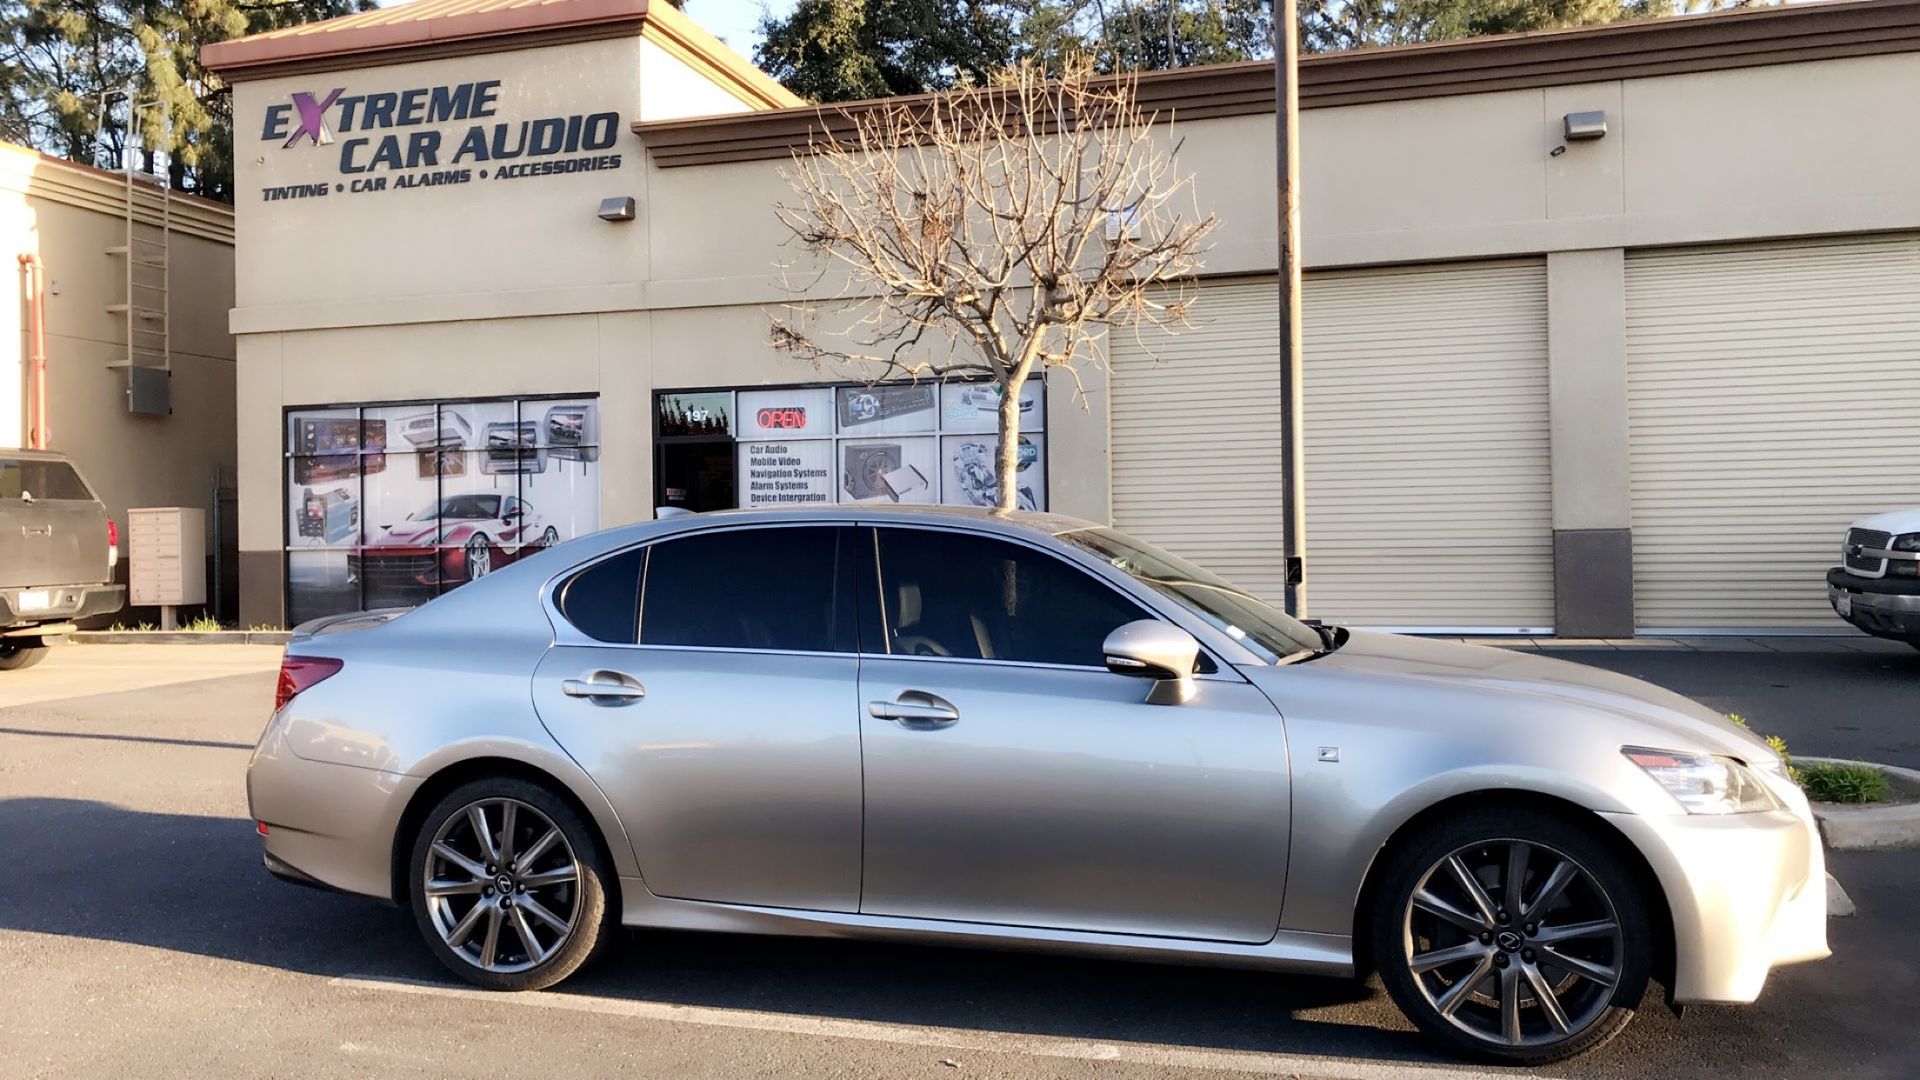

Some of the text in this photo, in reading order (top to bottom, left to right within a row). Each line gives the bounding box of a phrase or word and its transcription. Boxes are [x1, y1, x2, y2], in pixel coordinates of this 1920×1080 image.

[261, 80, 501, 148] EXTREME
[340, 112, 620, 174] CAR AUDIO
[262, 155, 622, 201] TINTING CAR ALARMS ACCESSORIES
[685, 410, 709, 421] 197
[758, 411, 806, 429] OPEN
[750, 445, 788, 455] Car Audio
[750, 457, 801, 467] Mobile Video
[750, 468, 828, 479] Navigation Systems
[750, 481, 809, 491] Alarm Systems
[750, 492, 827, 503] Device Intergration
